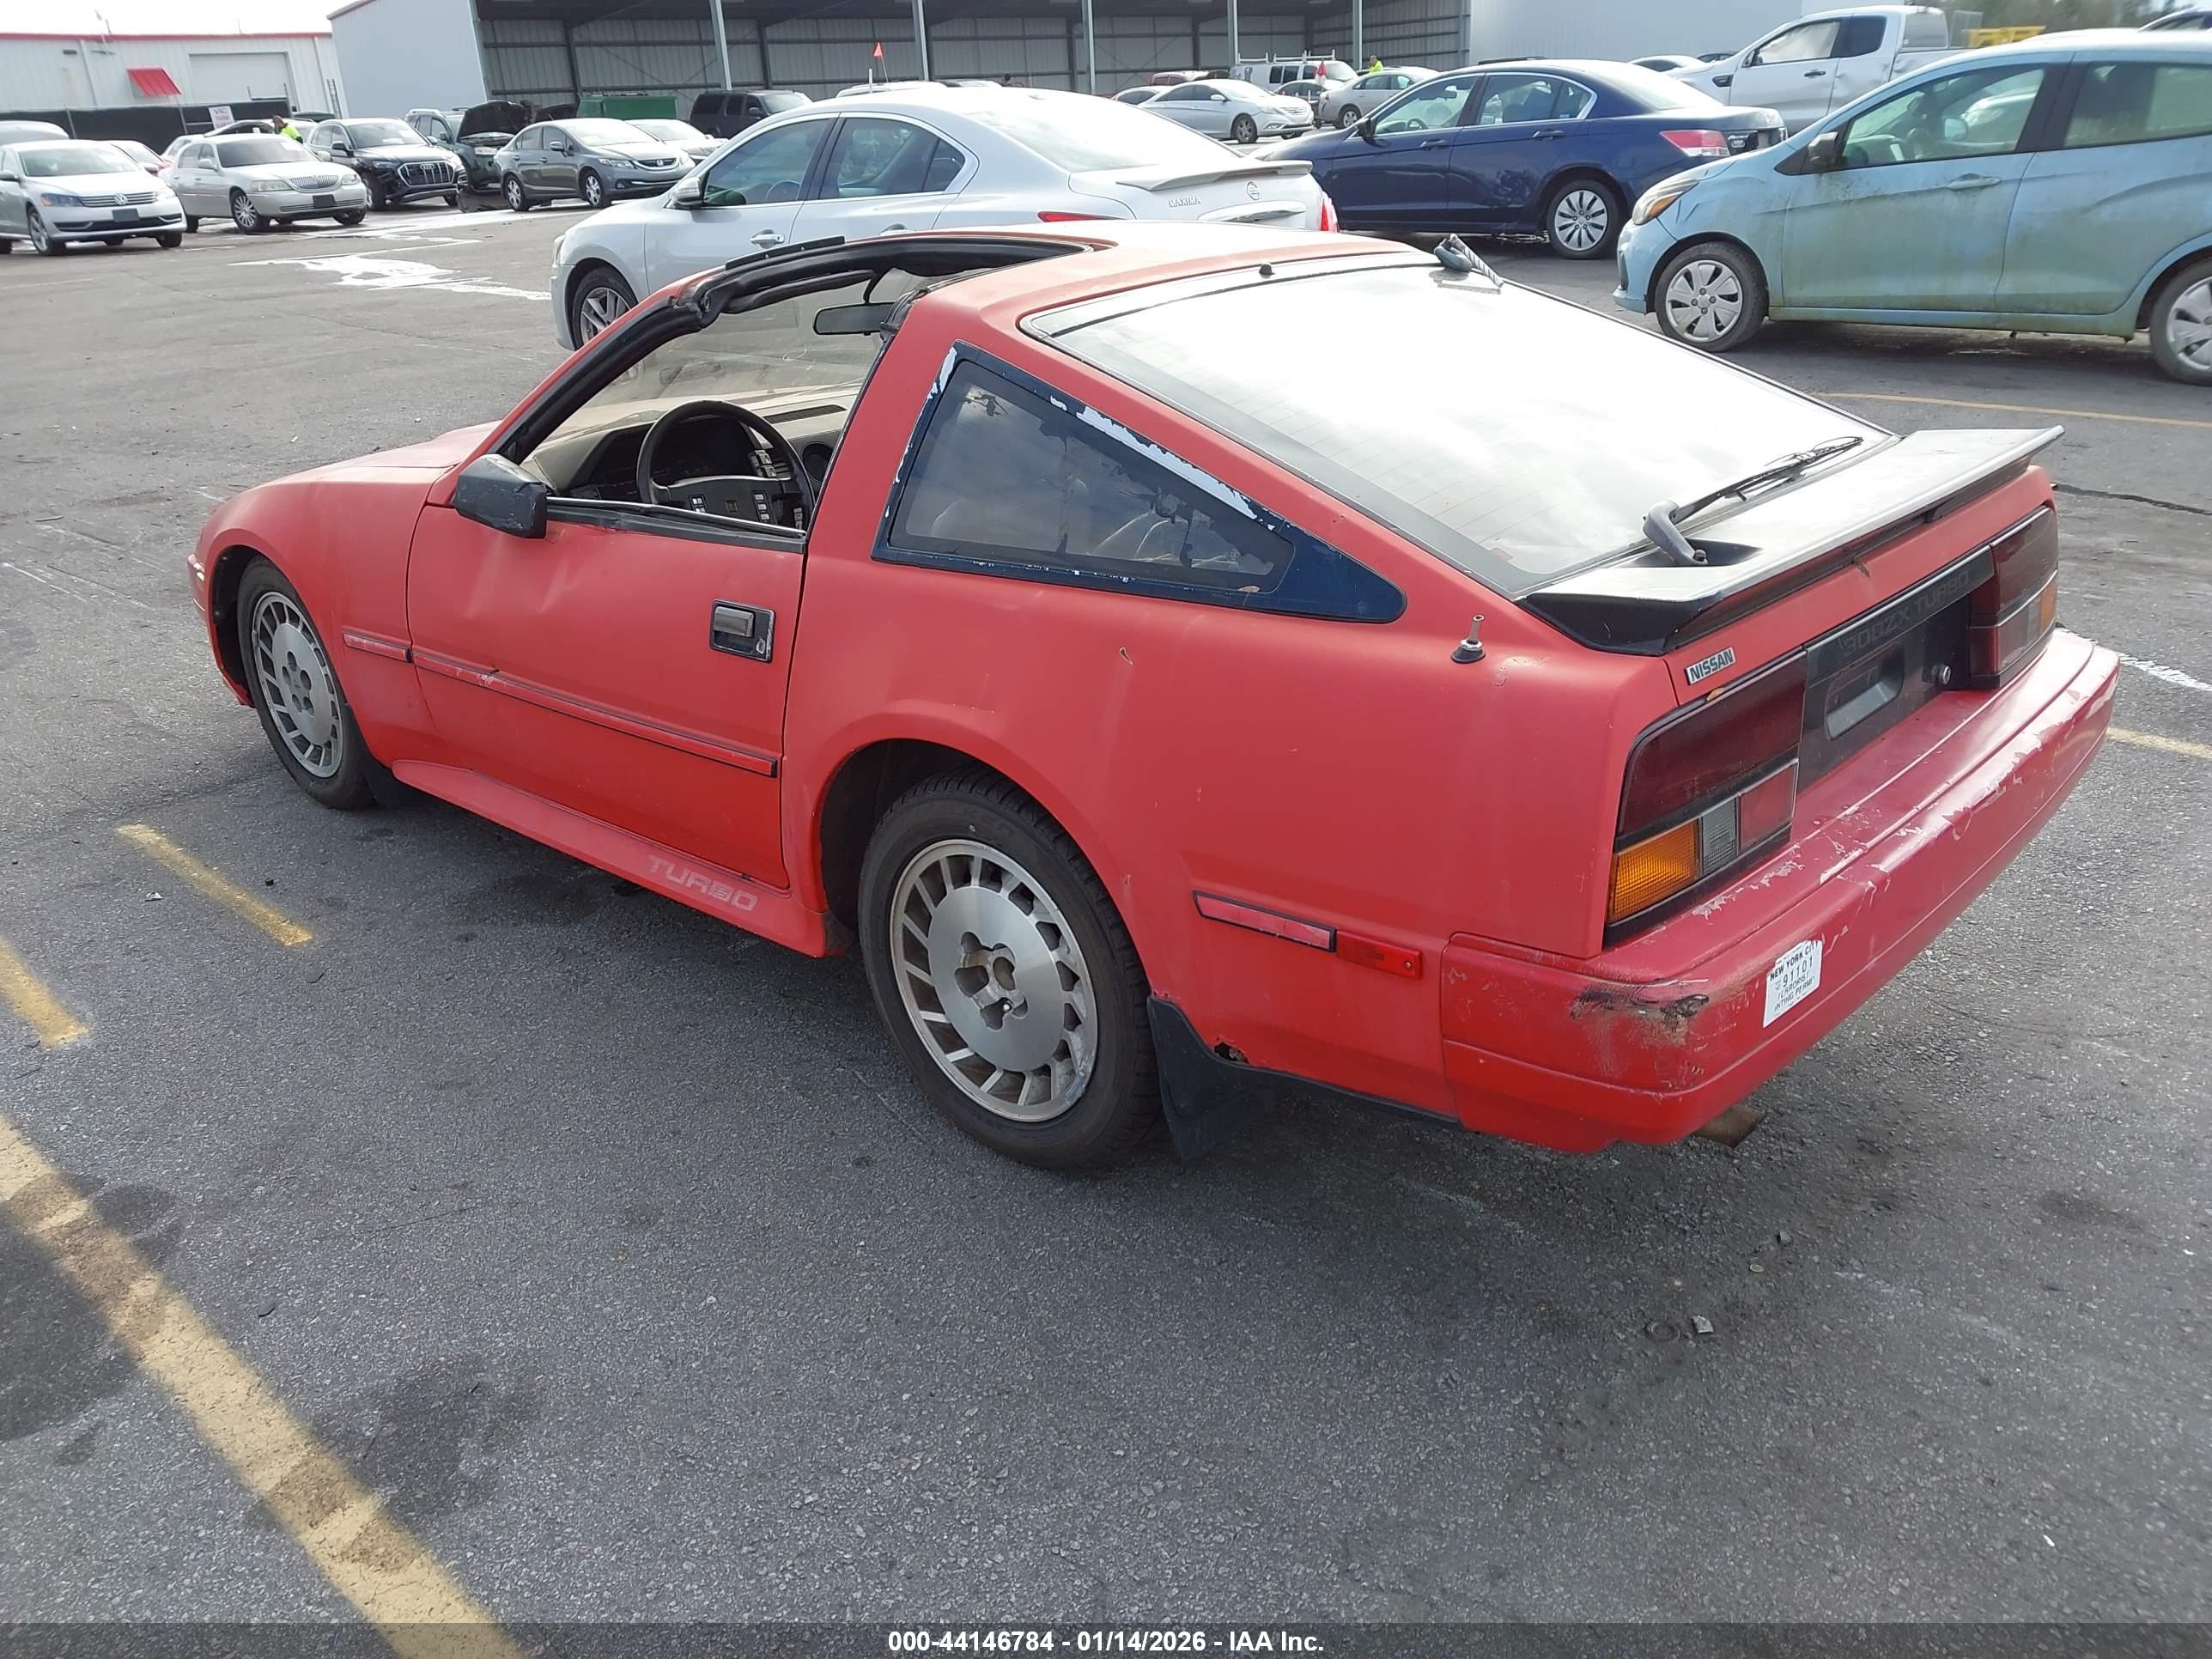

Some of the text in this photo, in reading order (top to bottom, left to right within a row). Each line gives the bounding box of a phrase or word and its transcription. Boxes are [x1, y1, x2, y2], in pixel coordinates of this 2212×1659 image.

[1169, 196, 1201, 208] MAXIMA
[1842, 569, 1970, 656] 300ZX TURBO
[1689, 648, 1734, 682] NISSAN
[647, 854, 758, 912] TURBO
[1770, 940, 1819, 981] NEW YORK CITY
[1783, 955, 1813, 988] 91101
